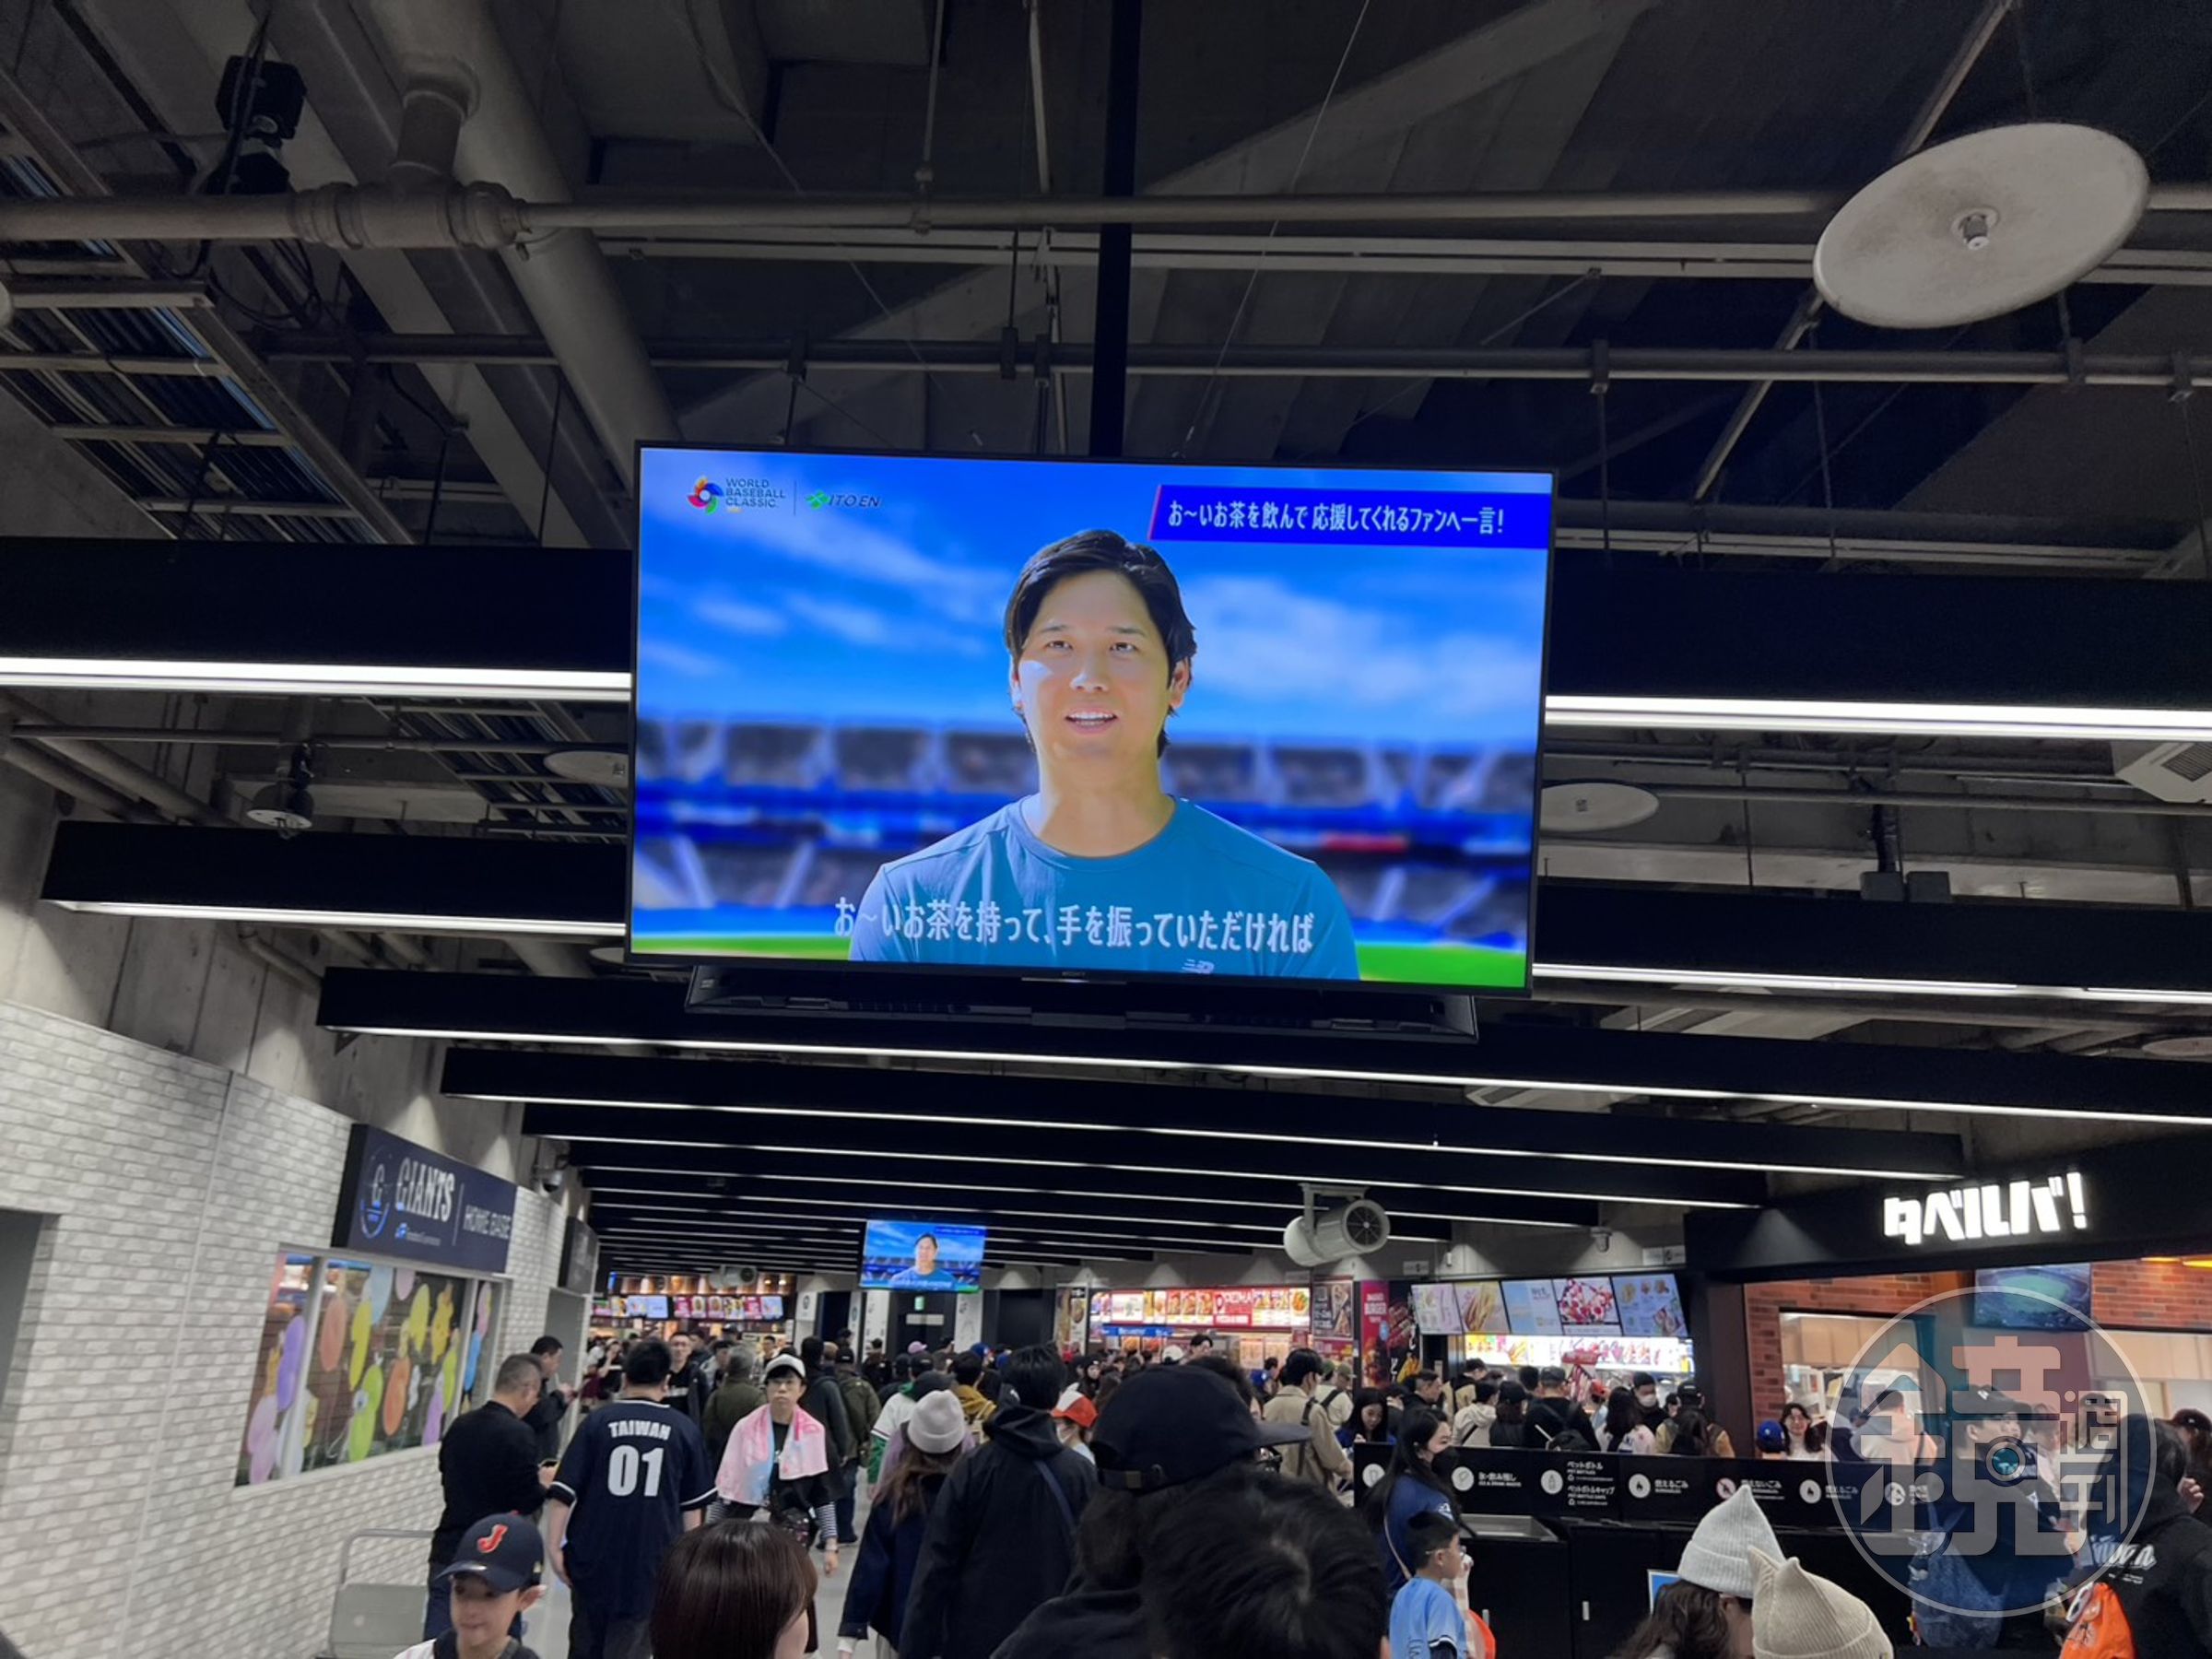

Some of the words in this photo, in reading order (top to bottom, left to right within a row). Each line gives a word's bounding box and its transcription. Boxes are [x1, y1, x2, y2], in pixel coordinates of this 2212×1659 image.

[725, 478, 770, 488] WORLD
[725, 488, 786, 499] BASEBALL
[725, 498, 777, 509] CLASSIC
[394, 1157, 455, 1223] GIANTS
[1884, 1171, 2087, 1244] タベルバ!
[608, 1420, 672, 1441] TAIWAN
[607, 1444, 664, 1497] 01
[477, 1524, 509, 1553] J
